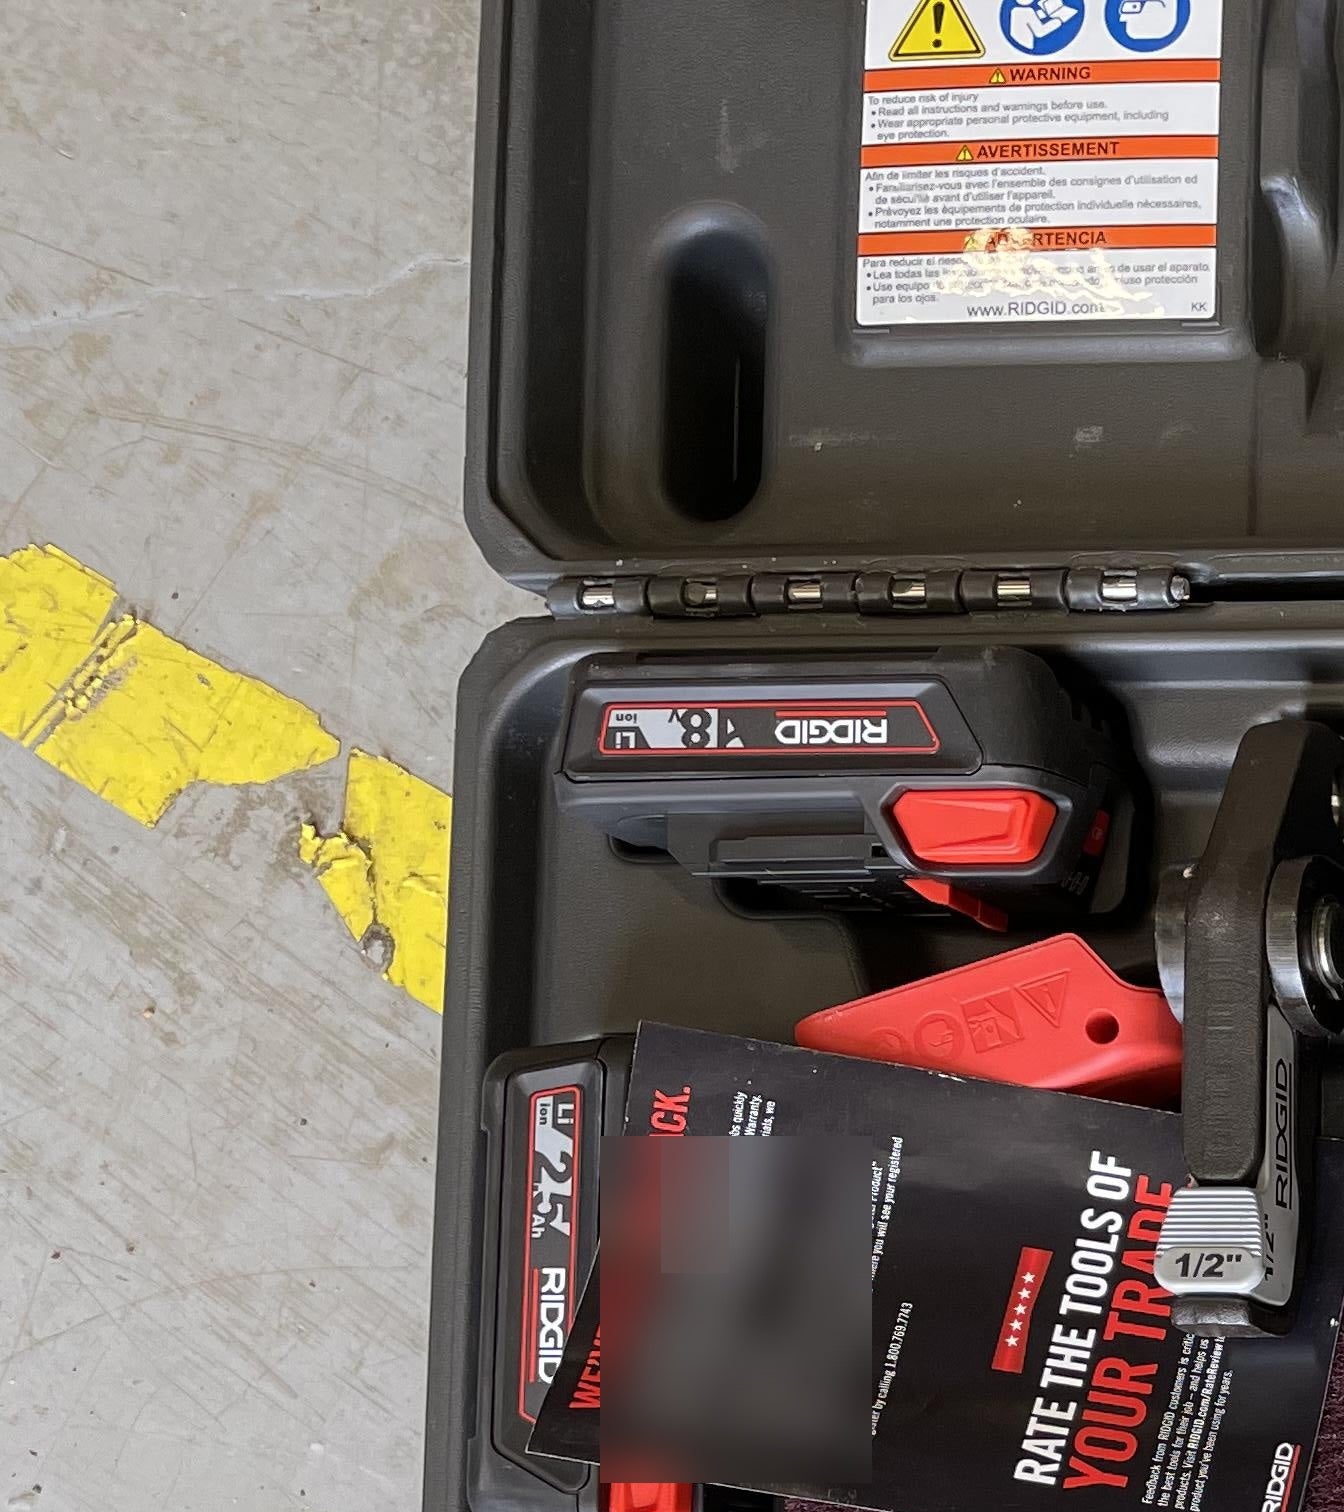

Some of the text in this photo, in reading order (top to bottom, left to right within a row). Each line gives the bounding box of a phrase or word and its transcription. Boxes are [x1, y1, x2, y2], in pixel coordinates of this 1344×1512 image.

[1009, 66, 1091, 82] WARNING
[868, 91, 979, 105] To reduce risk of injury
[878, 106, 905, 116] Read
[908, 105, 919, 115] all
[922, 104, 978, 114] instructions
[981, 102, 1000, 112] and
[1003, 101, 1048, 113] warnings
[1051, 100, 1083, 110] before
[878, 110, 1169, 129] Wear appropriate personal protective equipment, including
[877, 130, 950, 142] eye protection.
[977, 142, 1120, 158] AVERTISSEMENT
[865, 171, 885, 181] Afin
[887, 170, 899, 180] de
[902, 169, 932, 180] limiter
[935, 168, 949, 178] les
[952, 167, 989, 179] risques
[965, 180, 990, 189] avec
[1049, 177, 1067, 187] des
[1070, 175, 1122, 187] consignes
[875, 195, 888, 205] de
[932, 193, 960, 203] avant
[924, 205, 939, 215] les
[1009, 203, 1022, 213] de
[1024, 200, 1075, 213] protection
[955, 216, 1005, 228] protection
[863, 258, 886, 268] Para
[889, 257, 923, 267] reducir
[873, 270, 892, 280] Lea
[895, 269, 922, 279] todas
[1117, 263, 1131, 273] de
[1133, 264, 1156, 273] usar
[873, 282, 893, 292] Use
[896, 282, 930, 294] equipo
[1144, 274, 1199, 286] protección
[872, 294, 895, 306] para
[898, 294, 912, 303] los
[1191, 302, 1208, 312] KK
[615, 712, 637, 723] ion
[615, 730, 636, 749] Li
[774, 718, 888, 745] RIDGID
[539, 1103, 551, 1126] ion
[557, 1103, 574, 1125] Li
[733, 1090, 748, 1123] quickly
[744, 1094, 763, 1136] Warranty.
[766, 1100, 776, 1114] we
[1275, 1058, 1289, 1209] RIDGID
[888, 1136, 904, 1183] registered
[884, 1182, 896, 1204] your
[881, 1203, 892, 1220] see
[877, 1220, 889, 1238] will
[873, 1238, 885, 1256] you
[1175, 1253, 1243, 1278] 1/2"
[538, 1267, 566, 1385] RIDGID
[1013, 1150, 1132, 1486] RATE THE TOOLS OF
[884, 1302, 914, 1368] 1.800.769.7743
[1062, 1174, 1175, 1489] YOUR TRADE
[1182, 1333, 1196, 1355] critic
[1199, 1338, 1209, 1350] us
[1191, 1351, 1207, 1374] helps
[878, 1369, 897, 1400] calling
[1168, 1367, 1187, 1410] customers
[1189, 1374, 1201, 1392] and
[872, 1399, 887, 1411] by
[1187, 1343, 1224, 1450] RIDGID.com/RateReview
[1214, 1394, 1227, 1407] for
[1157, 1411, 1176, 1441] RIDGID
[1176, 1416, 1190, 1435] their
[1210, 1407, 1226, 1431] using
[1171, 1435, 1185, 1449] for
[1202, 1431, 1217, 1452] been
[1151, 1443, 1168, 1462] from
[1166, 1450, 1181, 1471] tools
[1182, 1450, 1197, 1469] Visit
[1141, 1464, 1162, 1504] Feedback
[1161, 1471, 1176, 1491] best
[1157, 1492, 1171, 1507] the
[1190, 1479, 1206, 1512] product
